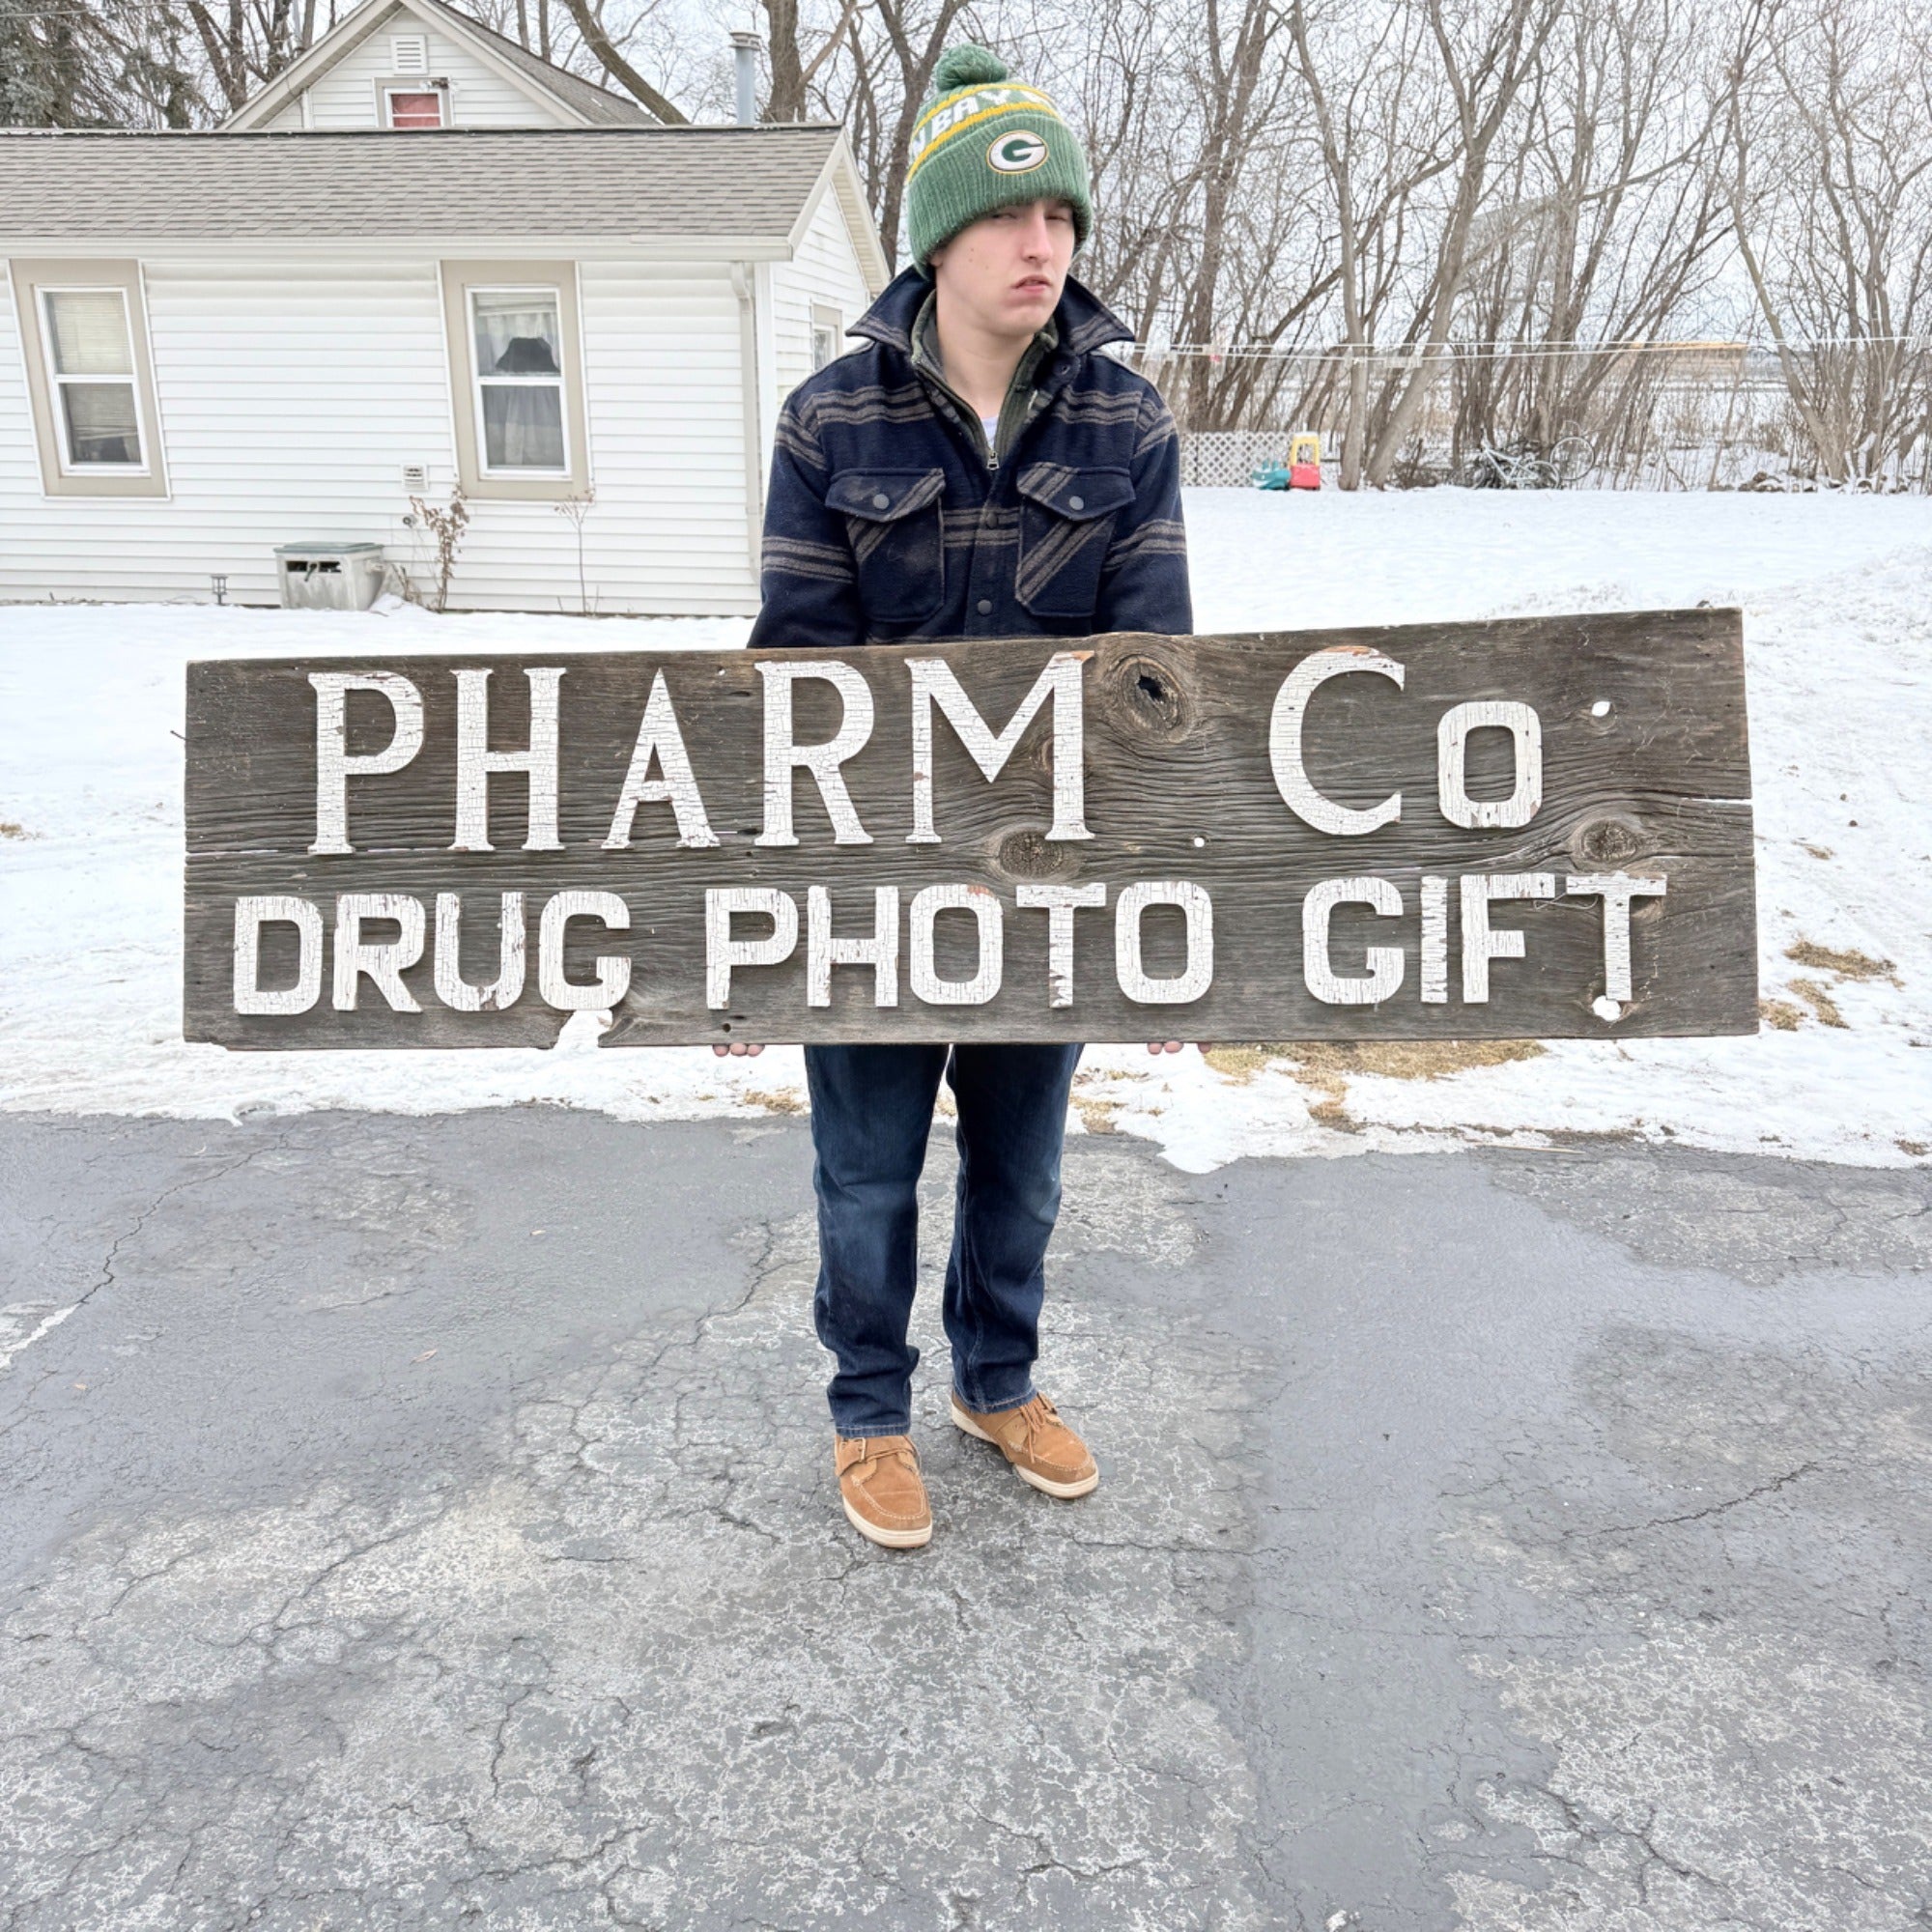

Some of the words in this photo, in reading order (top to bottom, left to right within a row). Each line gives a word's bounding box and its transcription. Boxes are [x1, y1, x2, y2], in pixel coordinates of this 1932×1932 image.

[930, 90, 1010, 137] BAY
[988, 130, 1046, 170] G
[308, 651, 1094, 855] PHARM
[1269, 645, 1543, 836] Co
[233, 890, 631, 1014] DRUG
[704, 881, 1213, 1009] PHOTO
[1302, 872, 1668, 1003] GIFT
